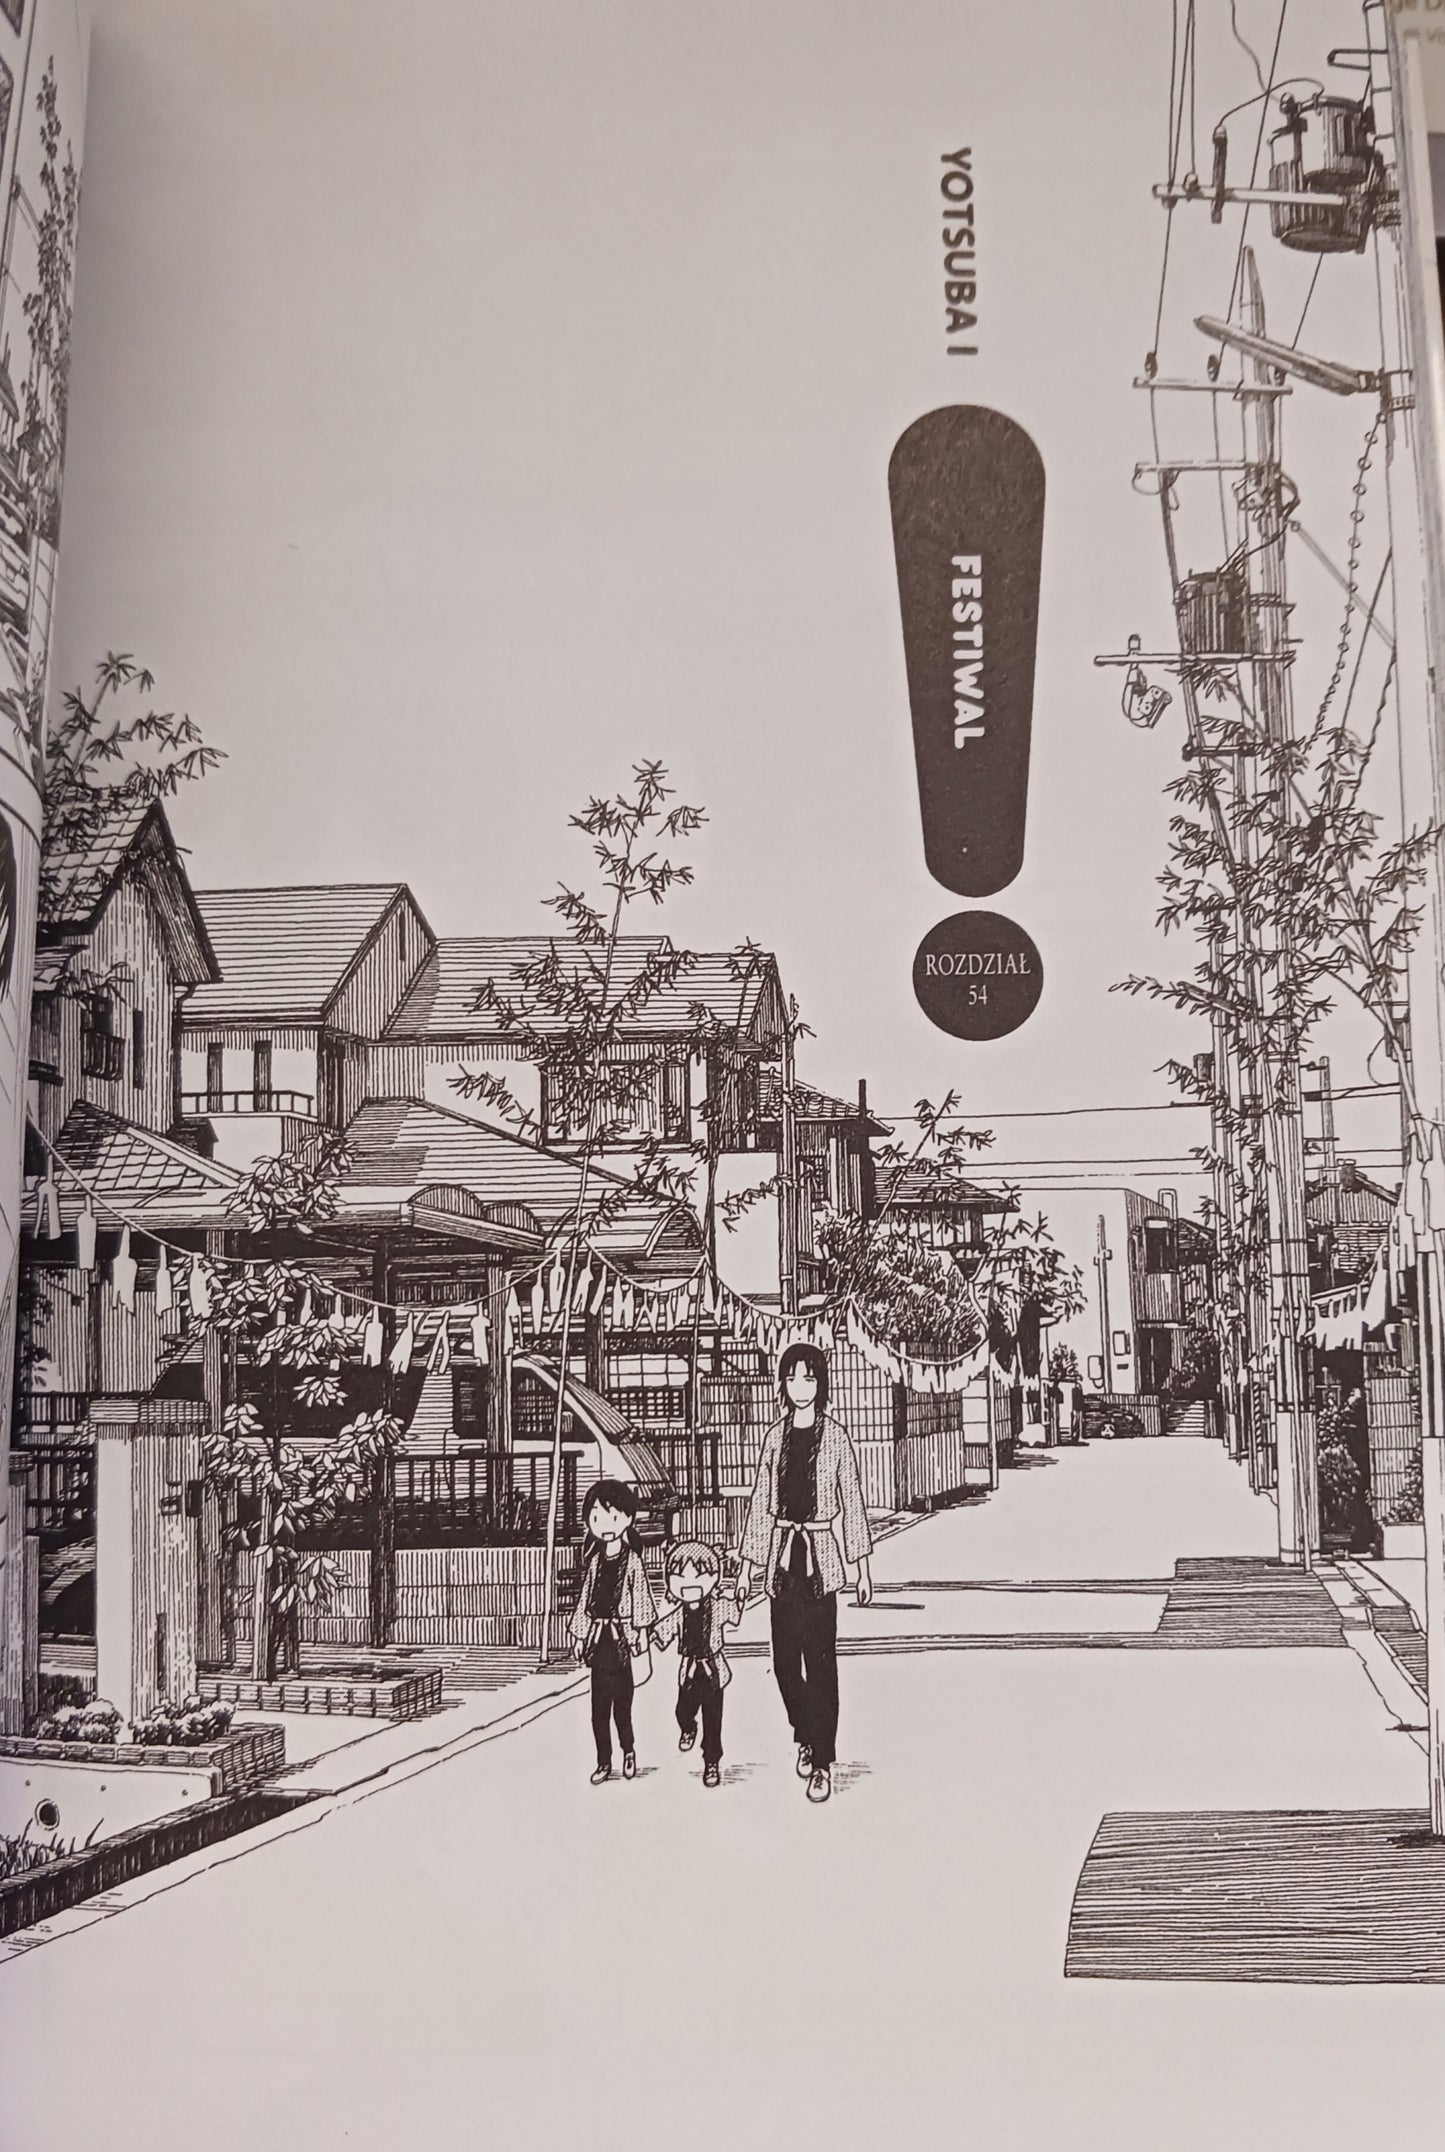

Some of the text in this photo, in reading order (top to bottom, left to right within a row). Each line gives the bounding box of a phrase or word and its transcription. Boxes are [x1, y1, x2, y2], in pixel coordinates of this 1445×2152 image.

[940, 146, 979, 356] YOTSUBA I
[951, 554, 985, 750] FESTIWAL
[925, 952, 1032, 977] ROZDZIAŁ
[967, 984, 989, 1006] 54
